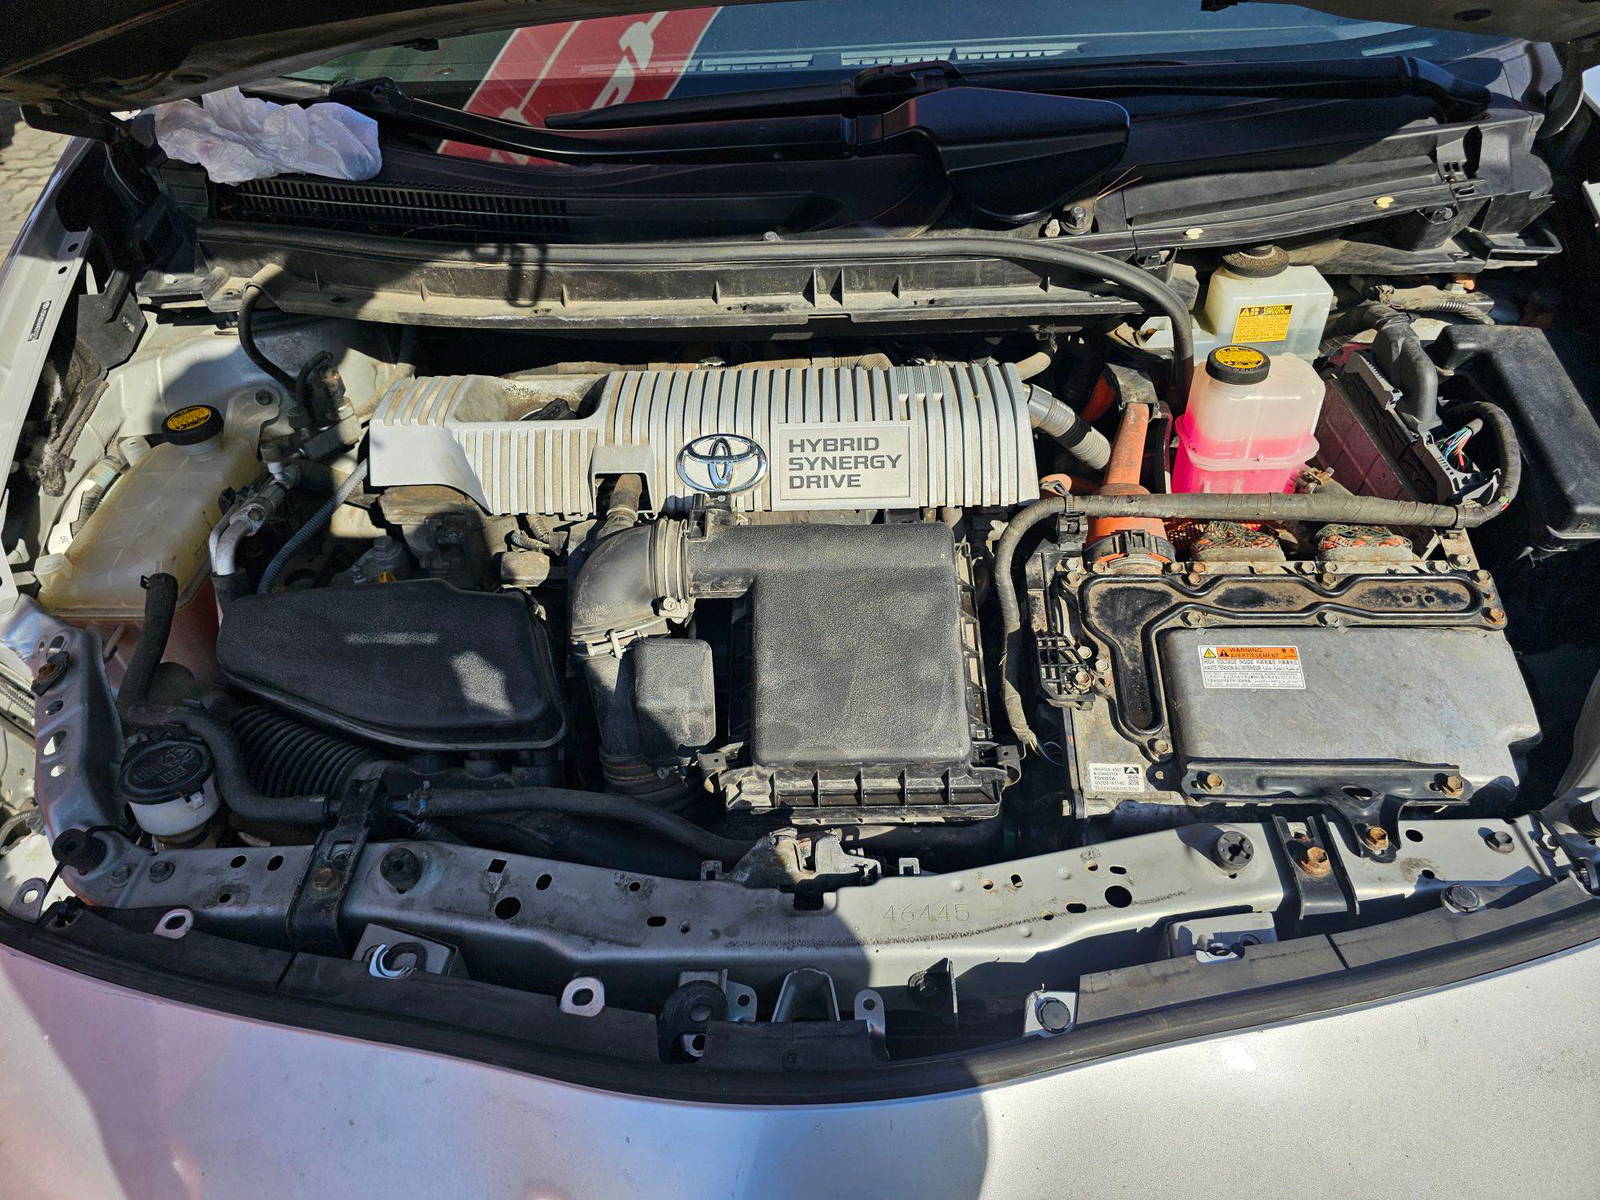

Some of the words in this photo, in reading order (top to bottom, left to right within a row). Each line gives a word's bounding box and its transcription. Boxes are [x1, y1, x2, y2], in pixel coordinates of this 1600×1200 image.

[788, 437, 880, 453] HYBRID
[788, 454, 902, 471] SYNERGY
[789, 474, 861, 489] DRIVE
[882, 903, 970, 922] 46445
